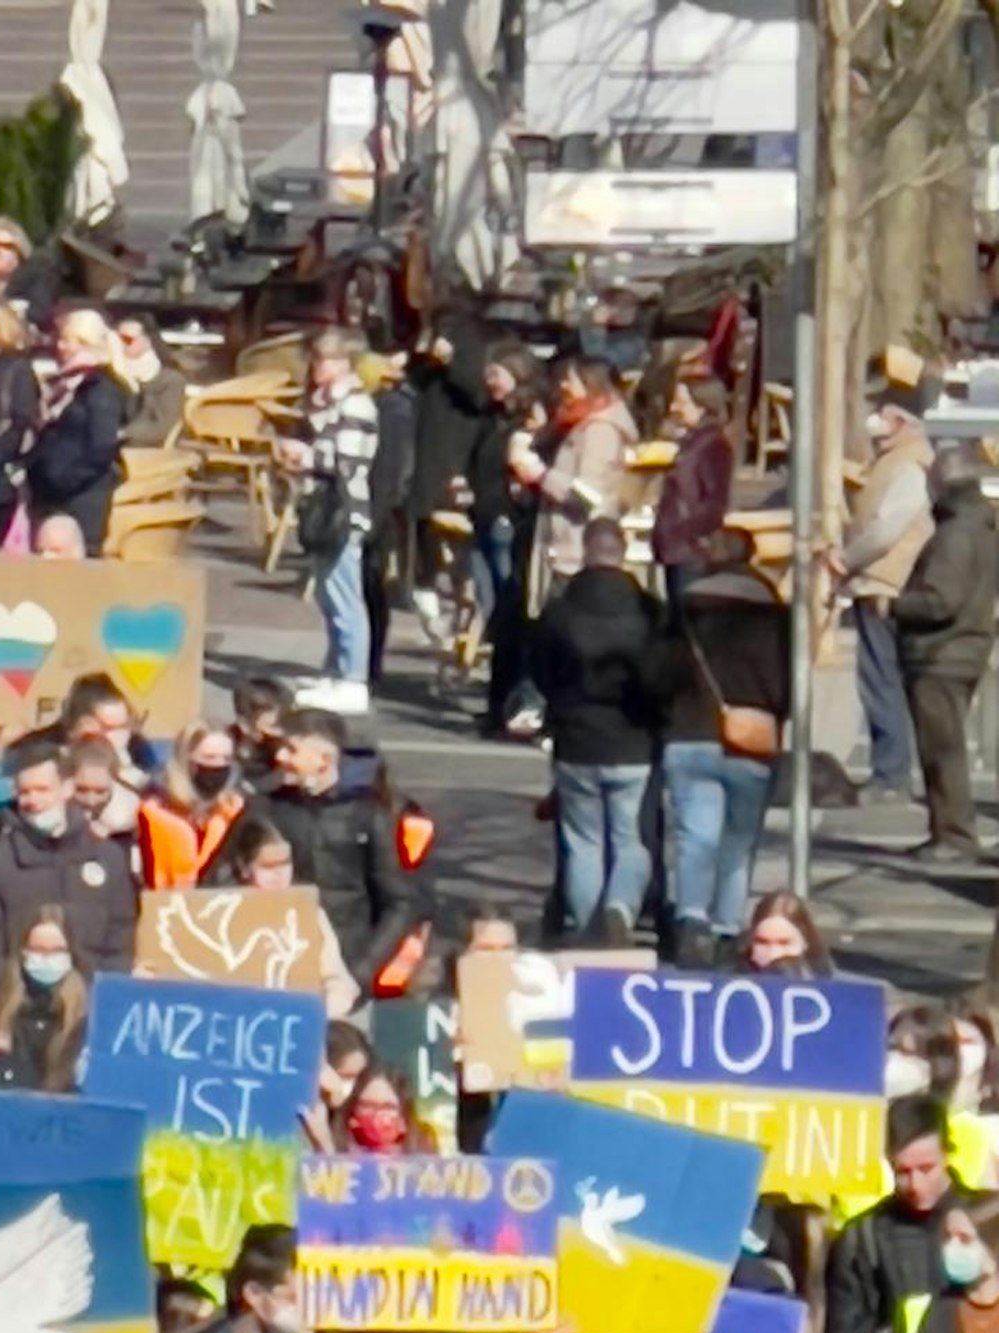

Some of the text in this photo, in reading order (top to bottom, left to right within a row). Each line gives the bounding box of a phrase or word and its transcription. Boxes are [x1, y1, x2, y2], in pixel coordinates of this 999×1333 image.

[111, 1001, 303, 1075] ANZEIGE
[611, 973, 831, 1075] STOP
[171, 1074, 263, 1144] IST
[301, 1160, 492, 1204] WE STAND
[457, 1268, 553, 1323] HAND
